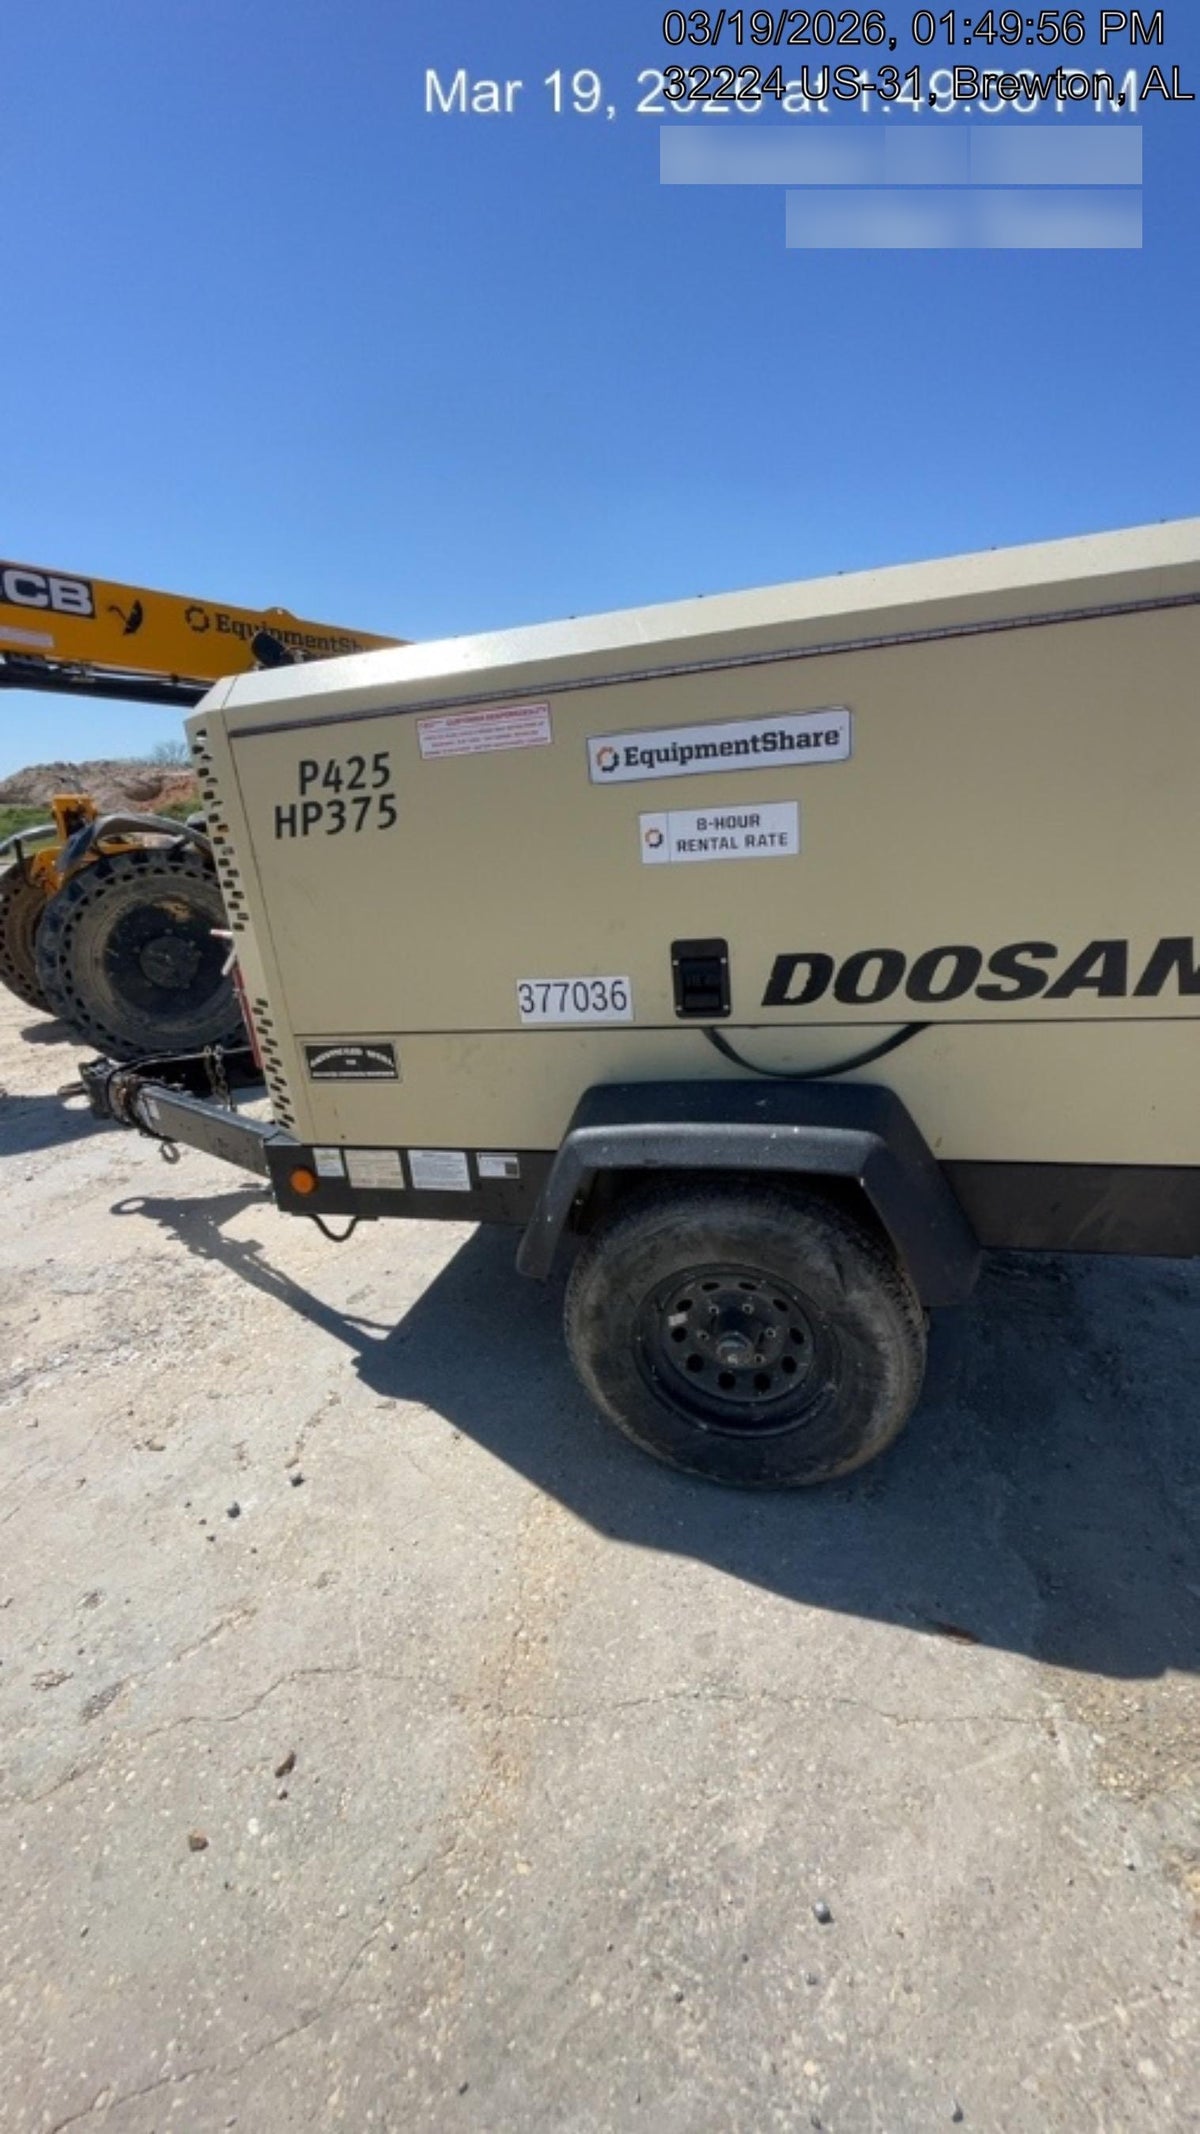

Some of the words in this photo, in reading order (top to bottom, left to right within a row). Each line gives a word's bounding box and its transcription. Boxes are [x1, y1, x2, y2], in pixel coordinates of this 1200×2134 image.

[0, 569, 93, 615] CB
[624, 729, 841, 769] EquipmentShare
[299, 752, 390, 796] P425
[275, 793, 398, 839] HP375
[676, 835, 739, 852] RENTAL
[744, 831, 788, 848] RATE
[518, 980, 628, 1014] 377036
